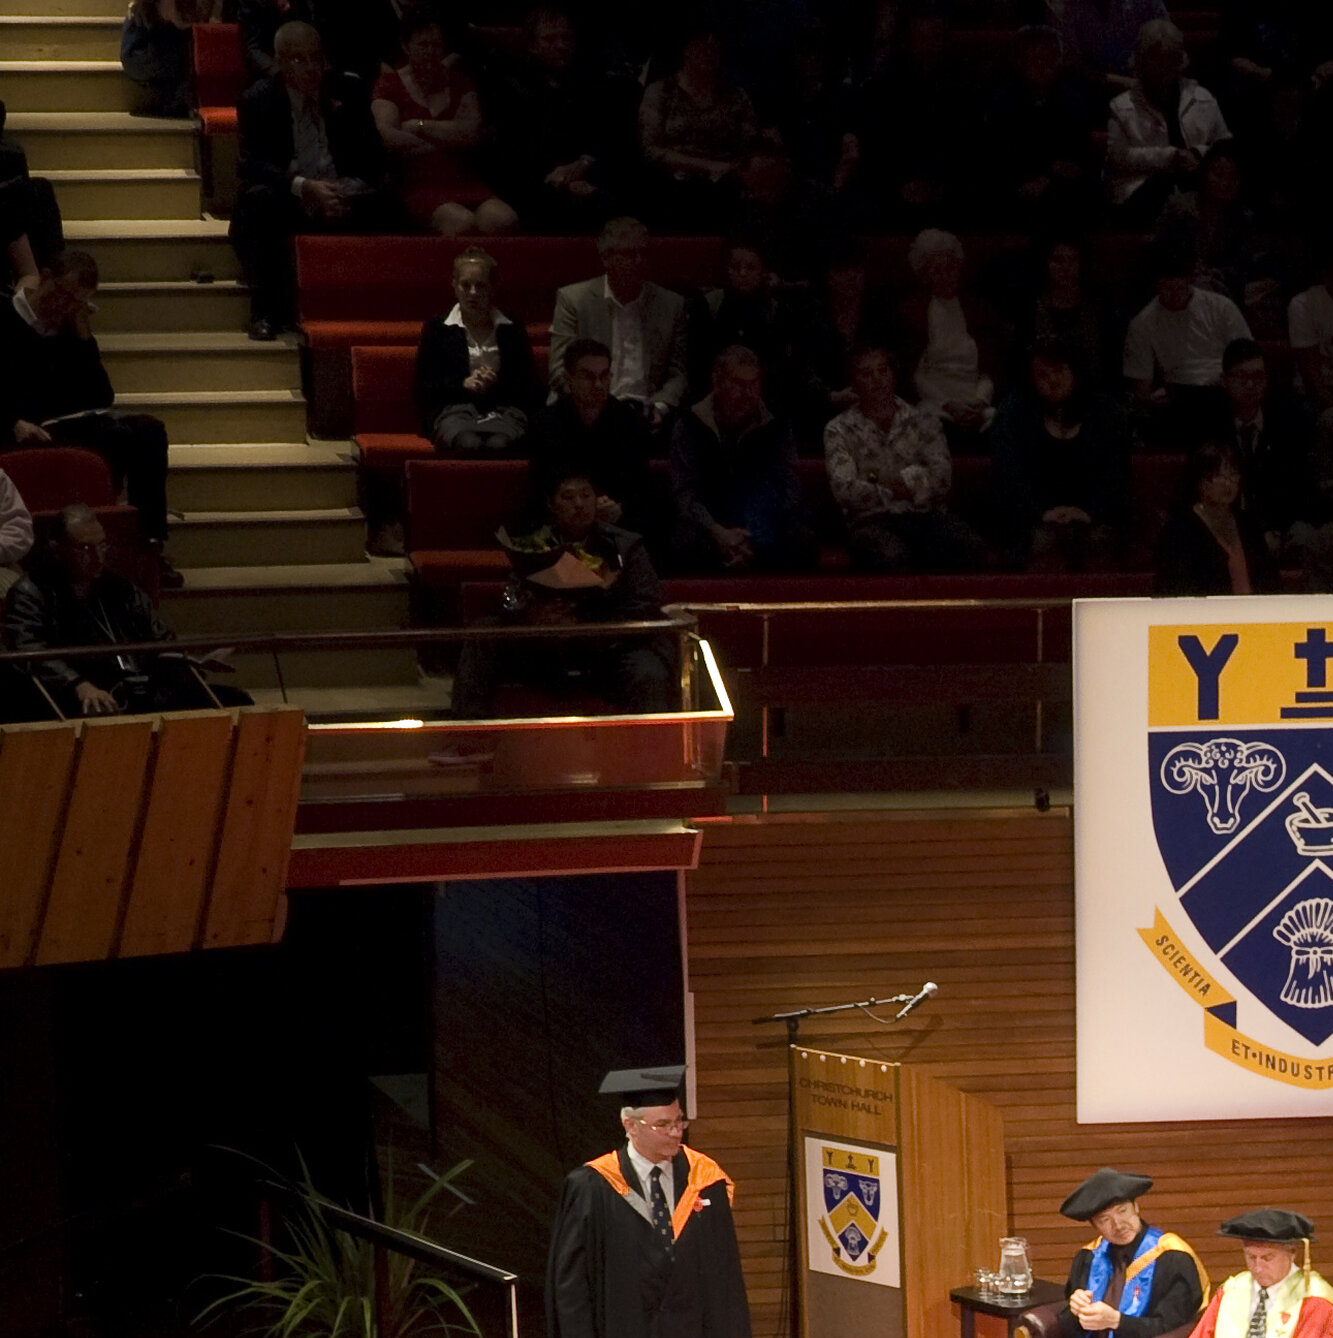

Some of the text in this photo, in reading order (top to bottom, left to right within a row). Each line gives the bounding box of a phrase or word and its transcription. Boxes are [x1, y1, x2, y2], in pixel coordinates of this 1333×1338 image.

[1154, 935, 1211, 997] SCIENTIA
[798, 1078, 893, 1103] CHRISTCHURCH
[811, 1094, 882, 1116] TOWN HALL
